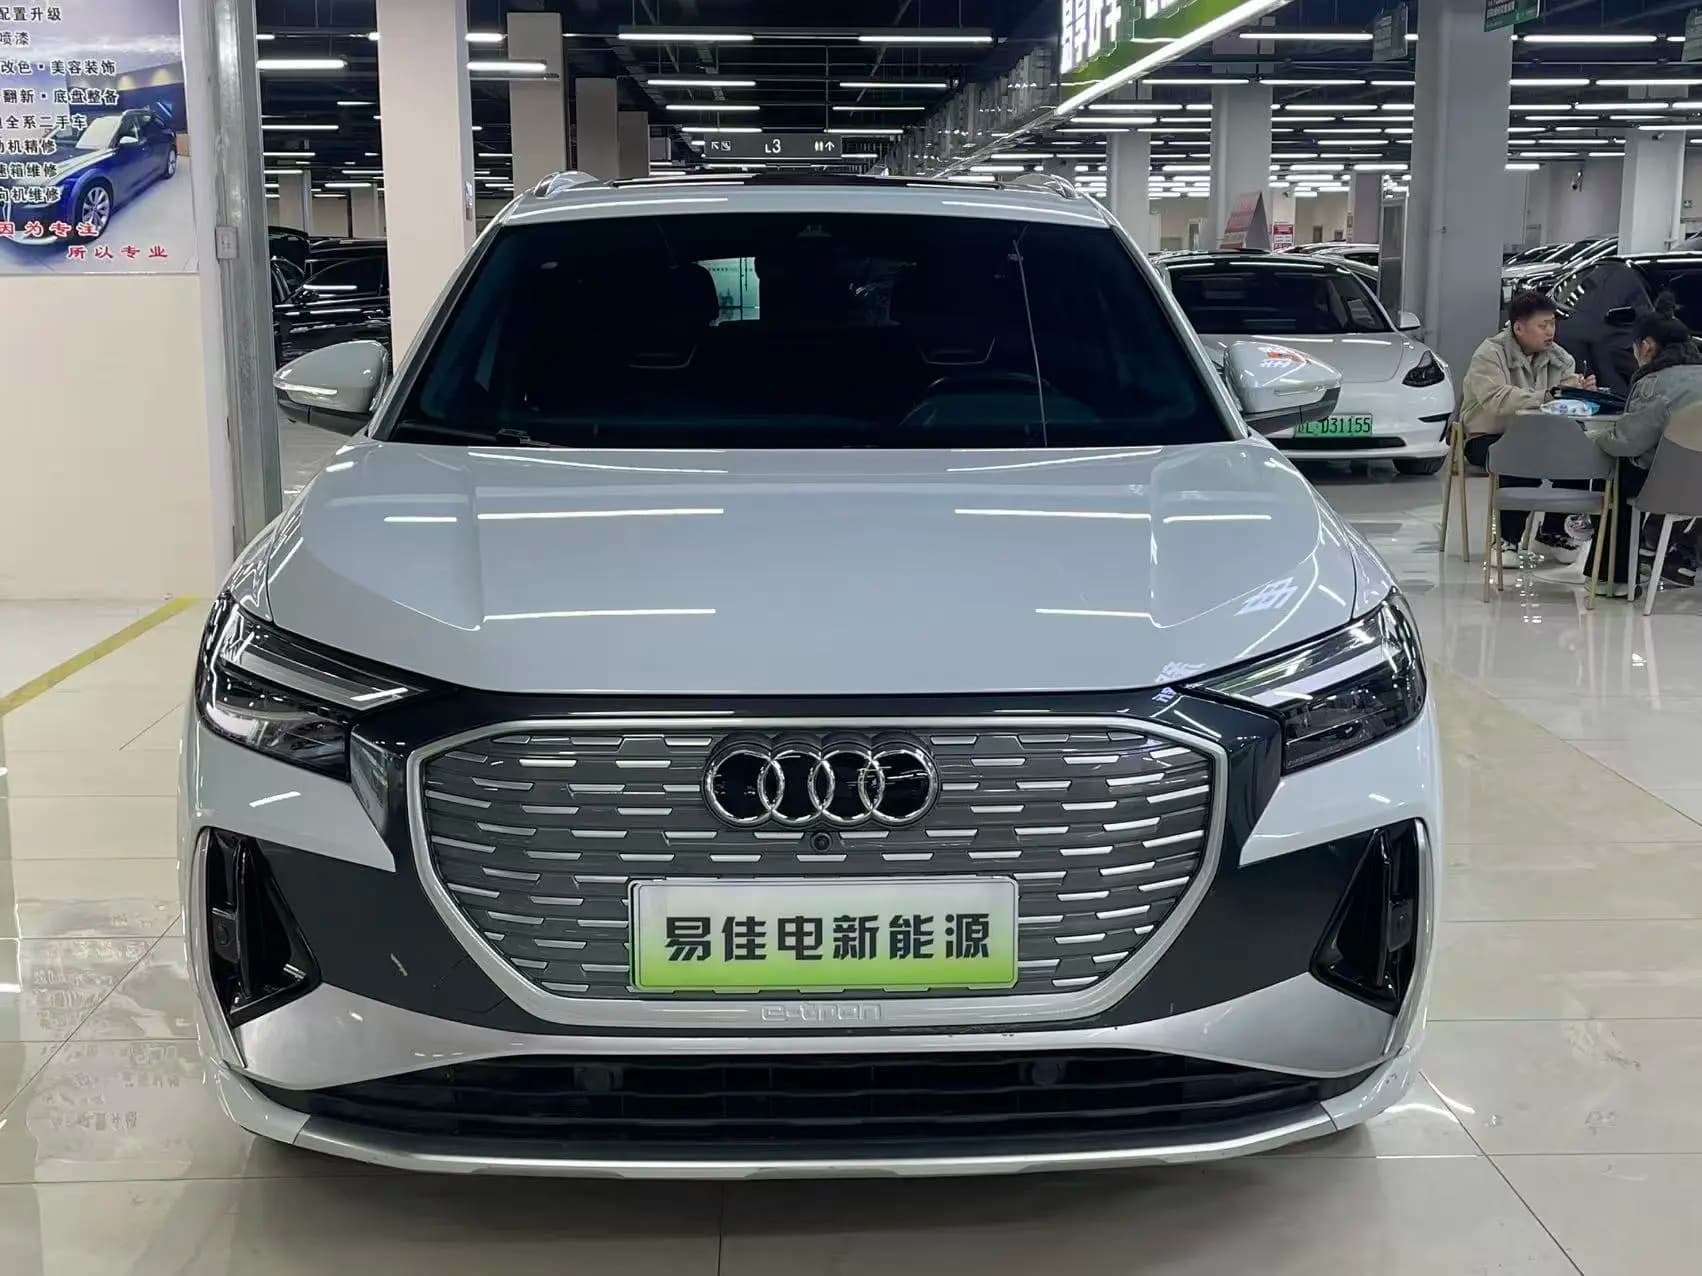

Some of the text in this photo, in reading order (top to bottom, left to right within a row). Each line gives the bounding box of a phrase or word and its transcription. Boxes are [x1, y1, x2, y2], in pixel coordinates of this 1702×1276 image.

[0, 115, 87, 129] 全系二手车
[765, 138, 781, 153] L3
[67, 245, 168, 260] 所以专业
[664, 913, 990, 962] 易佳电新能源
